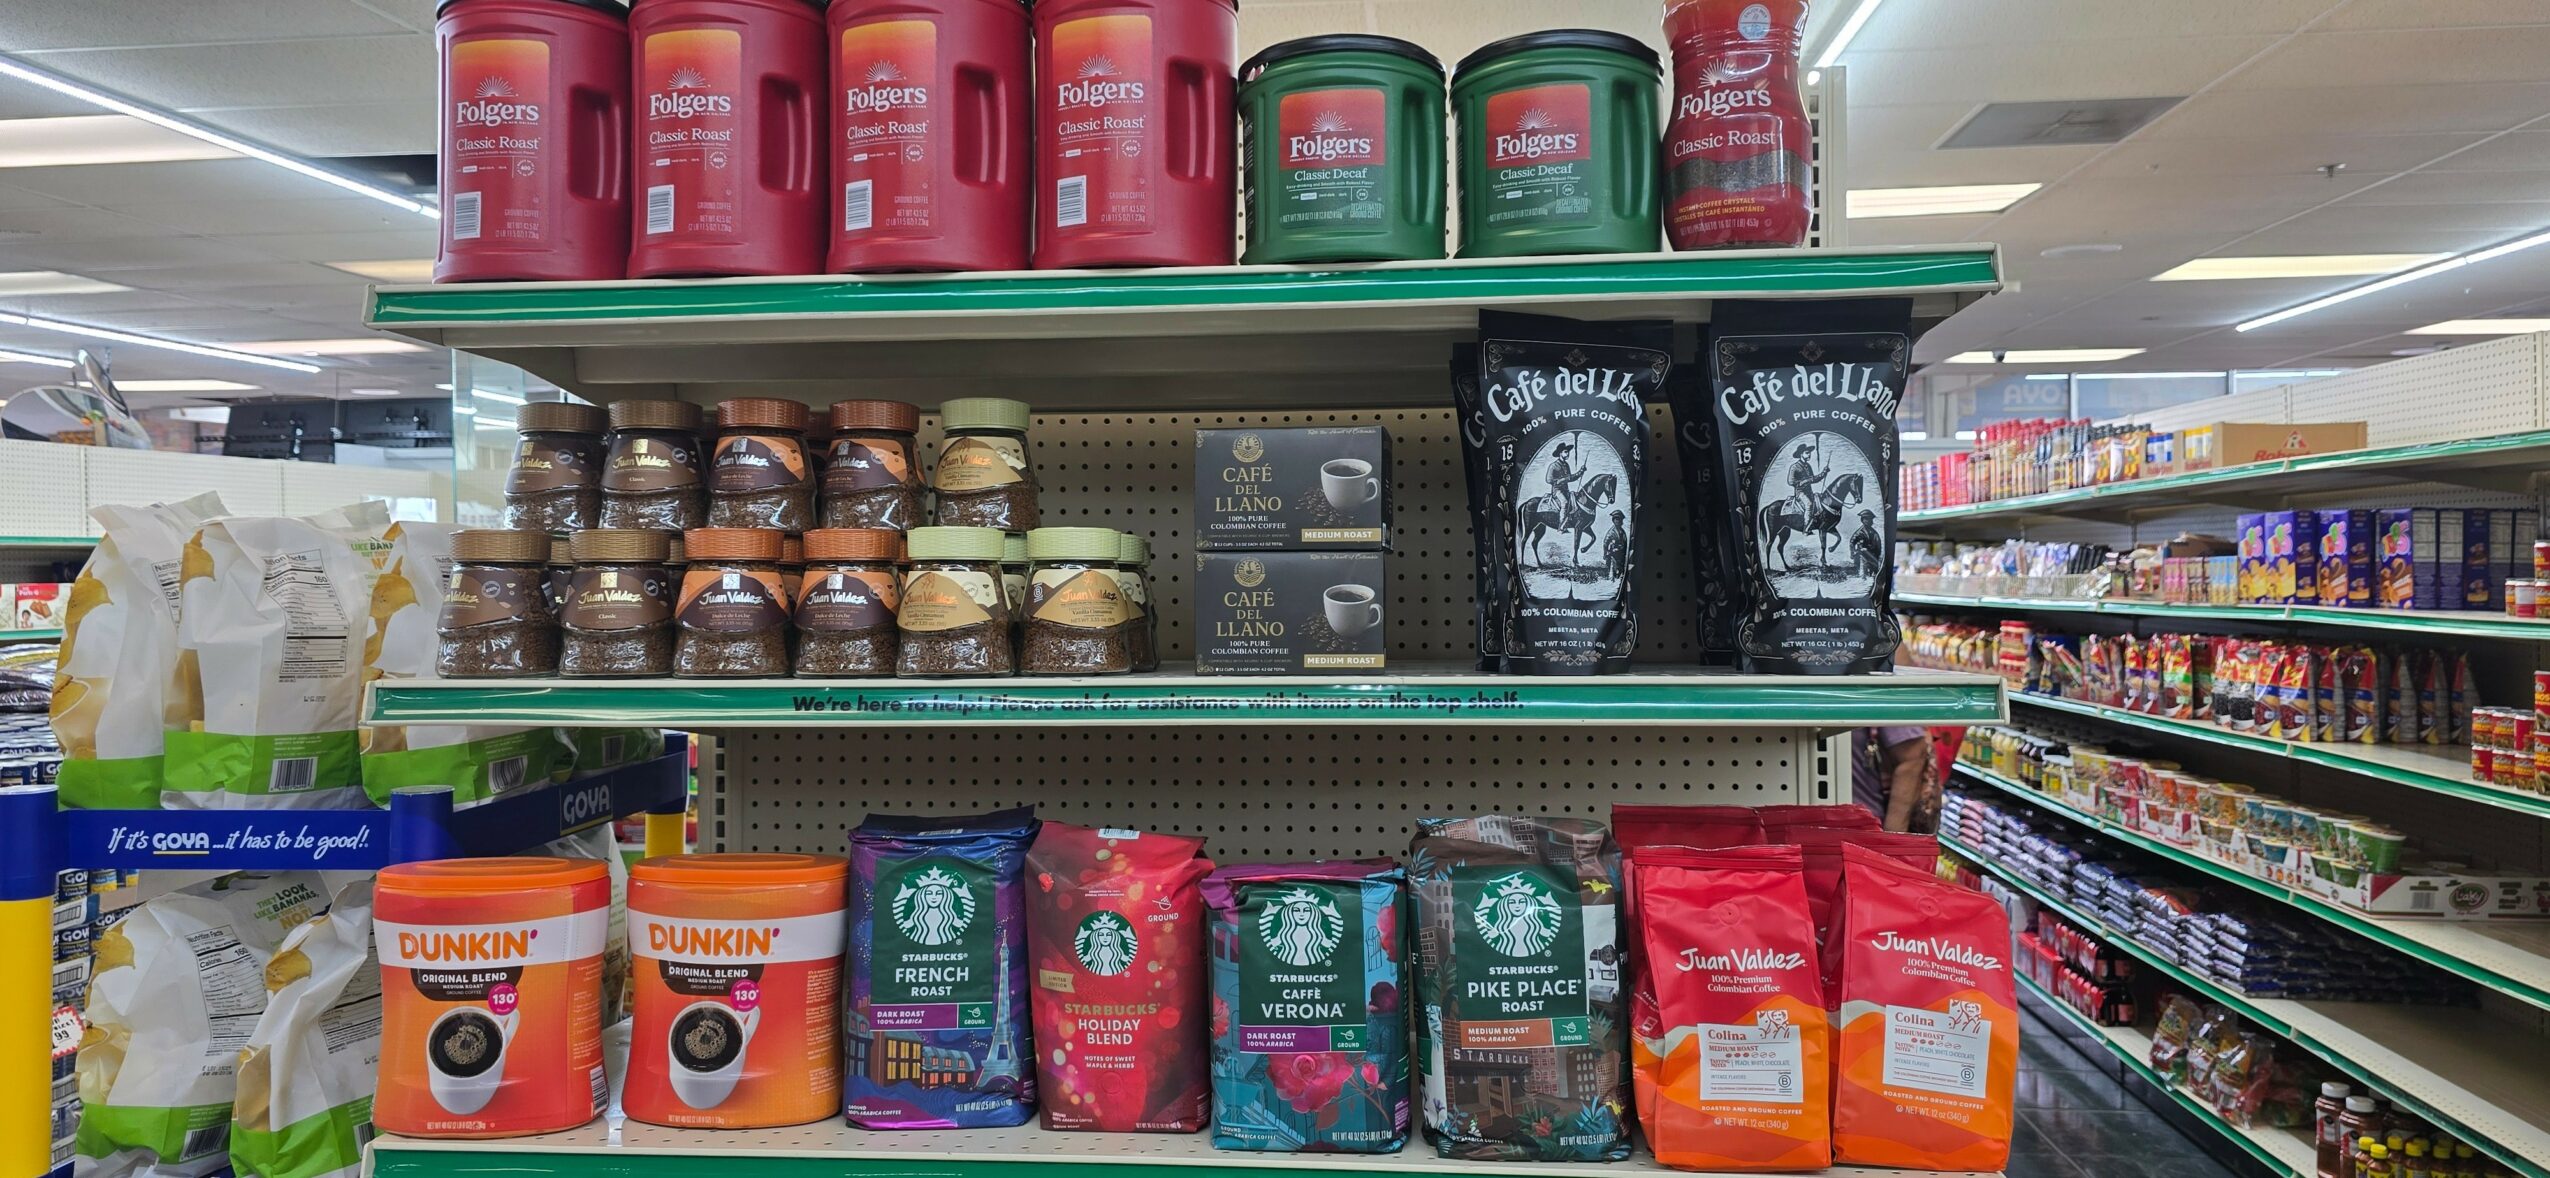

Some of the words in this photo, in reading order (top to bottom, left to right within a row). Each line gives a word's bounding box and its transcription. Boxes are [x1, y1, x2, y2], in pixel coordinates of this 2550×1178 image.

[847, 85, 927, 112] Folgers
[1058, 80, 1144, 108] Folgers
[650, 92, 731, 118] Folgers
[1678, 89, 1771, 120] Folgers
[456, 101, 539, 126] Folgers
[847, 123, 885, 140] Classic
[888, 122, 927, 134] Roast
[1059, 118, 1100, 135] Classic
[1104, 117, 1144, 129] Roast
[456, 137, 495, 151] Classic
[500, 136, 538, 149] Roast
[650, 129, 688, 144] Classic
[692, 128, 731, 140] Roast
[1290, 135, 1370, 160] Folgers
[1496, 133, 1576, 158] Folgers
[1674, 133, 1722, 157] Classic
[1728, 131, 1775, 145] Roast
[1295, 170, 1330, 181] Classic
[1334, 168, 1367, 178] Decaf
[1501, 167, 1535, 180] Classic
[1538, 163, 1573, 175] Decaf
[1700, 201, 1722, 209] COFFEE
[1487, 368, 1547, 422] Café
[1554, 367, 1595, 398] del
[1720, 371, 1785, 425] Café
[1791, 363, 1833, 398] del
[1841, 362, 1896, 421] Llano
[1521, 415, 1547, 435] 100%
[1554, 408, 1586, 420] PURE
[1591, 411, 1631, 435] COFFEE
[1758, 418, 1786, 438] 100%
[1793, 409, 1825, 421] PURE
[1831, 411, 1876, 434] COFFEE
[1736, 446, 1752, 465] 18
[1223, 463, 1272, 482] CAFÉ
[1235, 485, 1260, 495] DEL
[1216, 497, 1281, 512] LLANO
[578, 591, 604, 604] Juan
[604, 590, 643, 602] Valdez
[699, 592, 727, 605] Juan
[727, 591, 765, 604] Valdez
[807, 592, 829, 604] Juan
[830, 591, 868, 604] Valdez
[1224, 588, 1274, 607] CAFÉ
[1237, 610, 1262, 619] DEL
[1543, 607, 1593, 618] COLOMBIAN
[1790, 607, 1845, 618] COLOMBIAN
[1216, 622, 1284, 636] LLANO
[793, 696, 851, 712] We're
[857, 696, 899, 711] here
[908, 697, 925, 711] to
[932, 694, 982, 715] help!
[989, 695, 1055, 711] Please
[1061, 693, 1096, 711] ask
[1102, 693, 1128, 711] for
[1137, 692, 1240, 710] assistance
[1248, 692, 1291, 709] with
[1297, 692, 1351, 709] items
[1358, 696, 1383, 709] on
[1389, 691, 1421, 709] the
[1428, 694, 1462, 713] top
[1468, 691, 1523, 709] shelf.
[563, 785, 610, 824] GOYA
[108, 827, 127, 853] If
[126, 830, 149, 850] it's
[153, 832, 209, 850] GOYA
[213, 831, 240, 849] ...it
[240, 826, 272, 849] has
[275, 831, 292, 849] to
[294, 825, 313, 849] be
[314, 825, 370, 860] good!
[1148, 913, 1179, 922] GROUND
[399, 929, 538, 961] DUNKIN'
[649, 923, 780, 956] DUNKIN'
[902, 953, 963, 961] STARBUCKS
[1872, 931, 1928, 955] Juan
[1931, 937, 2003, 970] Valdez
[1675, 948, 1730, 972] Juan
[1731, 949, 1806, 972] Valdez
[1907, 958, 1930, 969] 100%
[1931, 962, 1969, 977] Premium
[422, 974, 469, 983] ORIGINAL
[472, 973, 507, 982] BLEND
[669, 966, 711, 977] ORIGINAL
[715, 969, 748, 977] BLEND
[896, 967, 969, 983] FRENCH
[1489, 966, 1553, 975] STARBUCKS
[1902, 967, 1949, 981] Colombian
[1950, 974, 1976, 987] Coffee
[1270, 975, 1333, 983] STARBUCKS
[1711, 975, 1733, 983] 100%
[1734, 975, 1772, 984] Premium
[911, 986, 952, 996] ROAST
[1283, 988, 1321, 999] CAFFÈ
[1468, 981, 1510, 998] PIKE
[1518, 980, 1577, 997] PLACE
[1708, 984, 1752, 993] Colombian
[1065, 1004, 1157, 1015] STARBUCKS
[1261, 1003, 1343, 1018] VERONA
[1502, 1001, 1544, 1012] ROAST
[1079, 1019, 1140, 1031] HOLIDAY
[1895, 1012, 1934, 1027] Colina
[1087, 1034, 1132, 1044] BLEND
[1708, 1029, 1747, 1041] Colina
[1454, 1049, 1529, 1064] STARBUCKS
